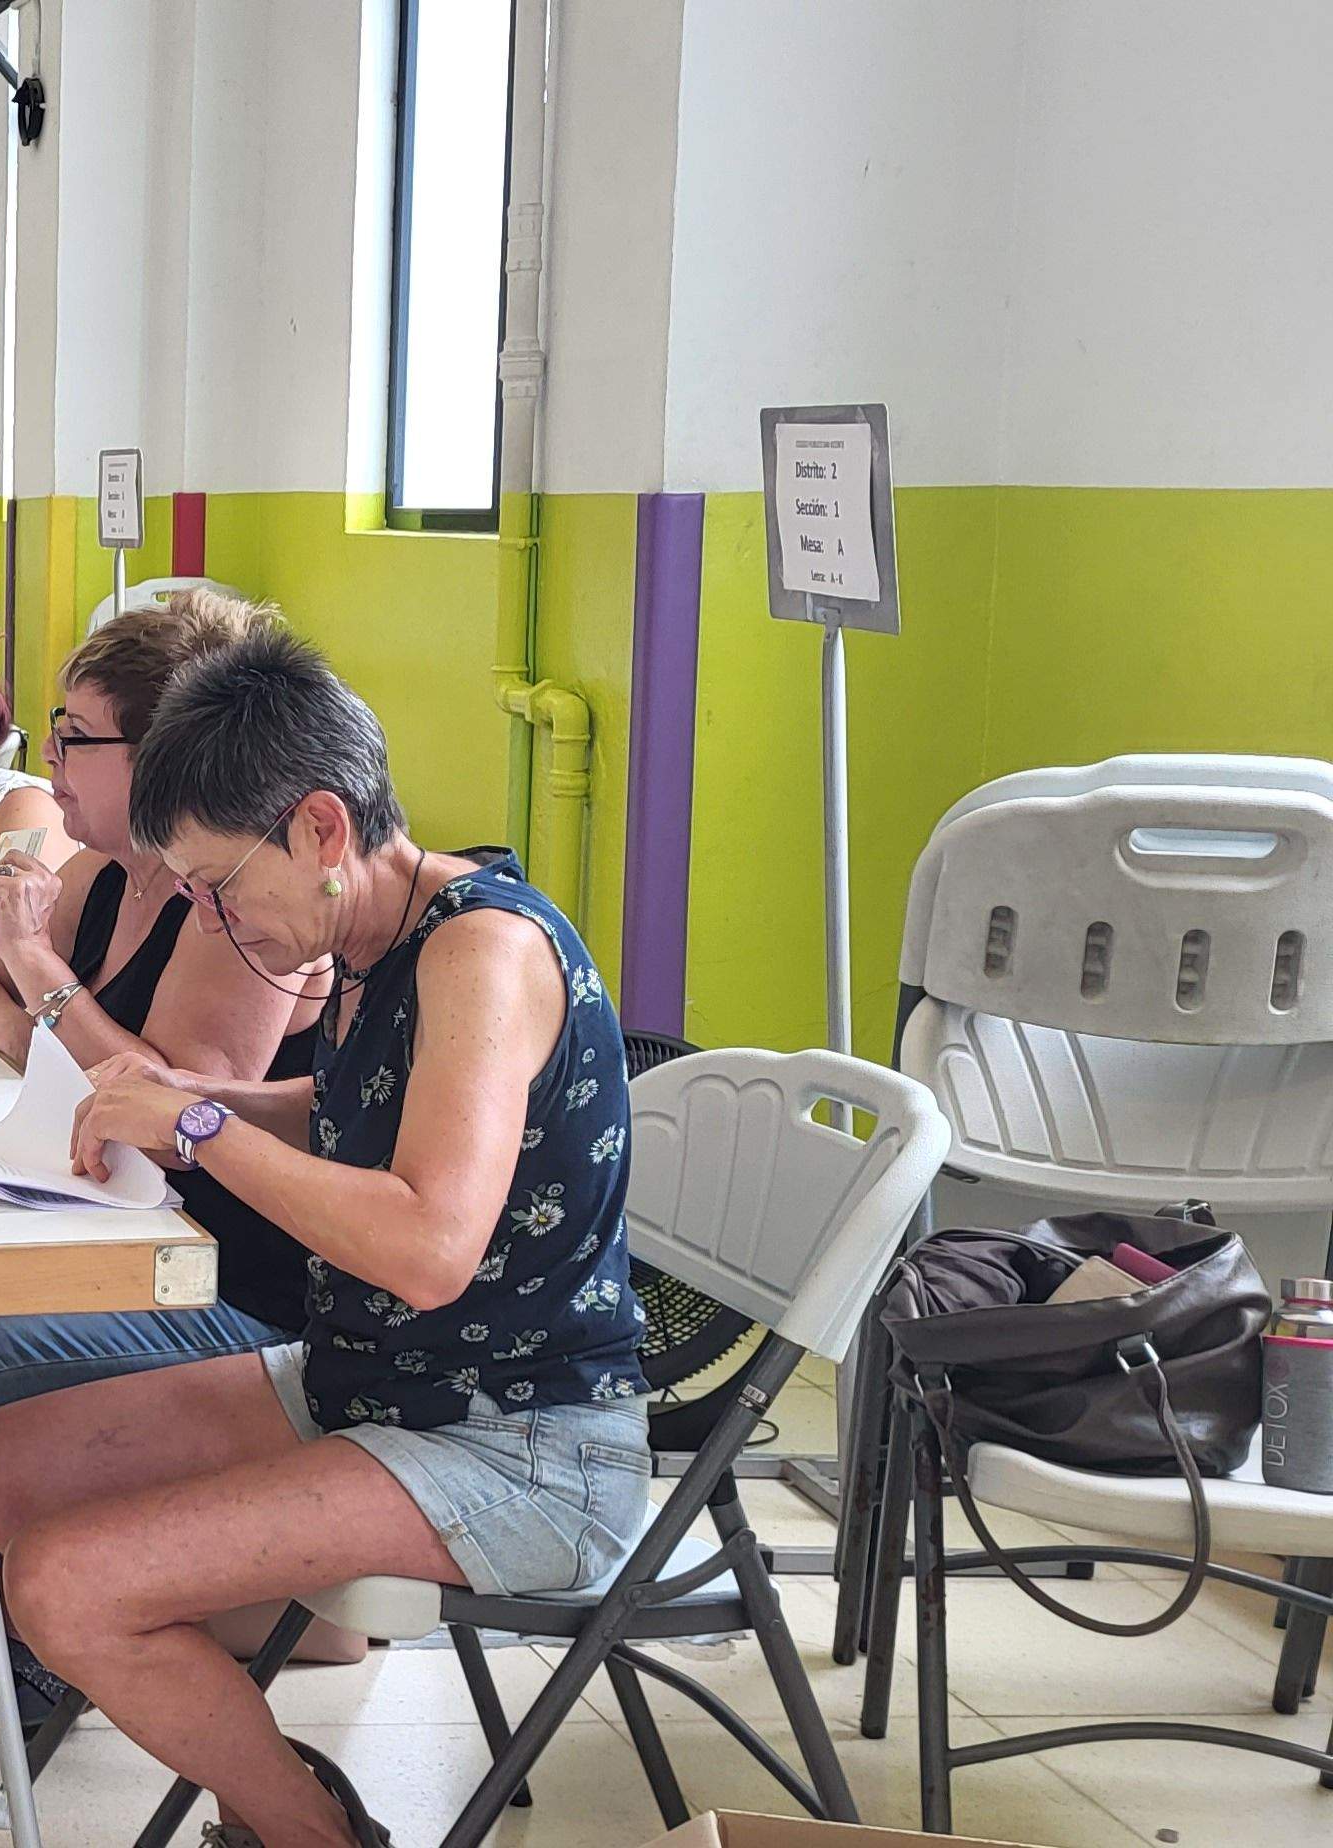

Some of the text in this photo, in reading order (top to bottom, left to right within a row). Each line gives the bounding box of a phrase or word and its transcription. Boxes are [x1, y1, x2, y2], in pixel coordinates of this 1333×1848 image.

[795, 461, 837, 479] Distrito: 2
[795, 498, 840, 518] Sección: 1
[799, 534, 844, 556] Mesa: A
[1265, 1382, 1289, 1467] DETOX
